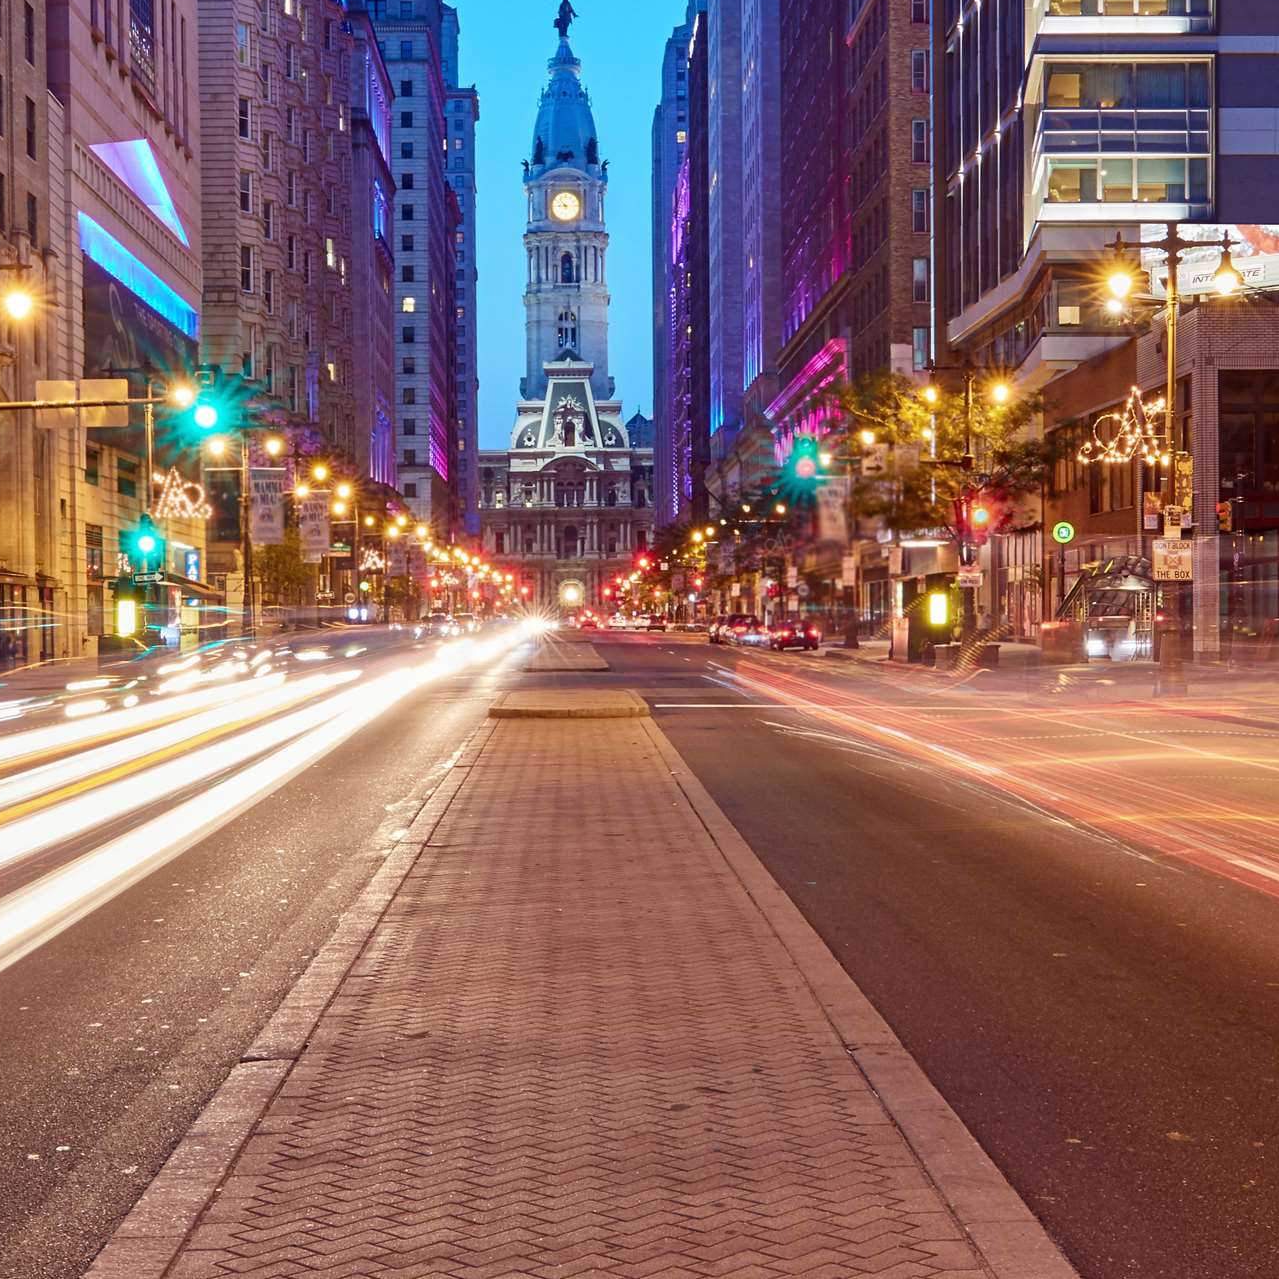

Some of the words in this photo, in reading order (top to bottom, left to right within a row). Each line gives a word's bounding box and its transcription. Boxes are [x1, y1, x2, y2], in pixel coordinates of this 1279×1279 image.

[1192, 268, 1261, 284] INTEATE
[1172, 542, 1190, 550] BLOCK
[1174, 570, 1190, 578] BOX
